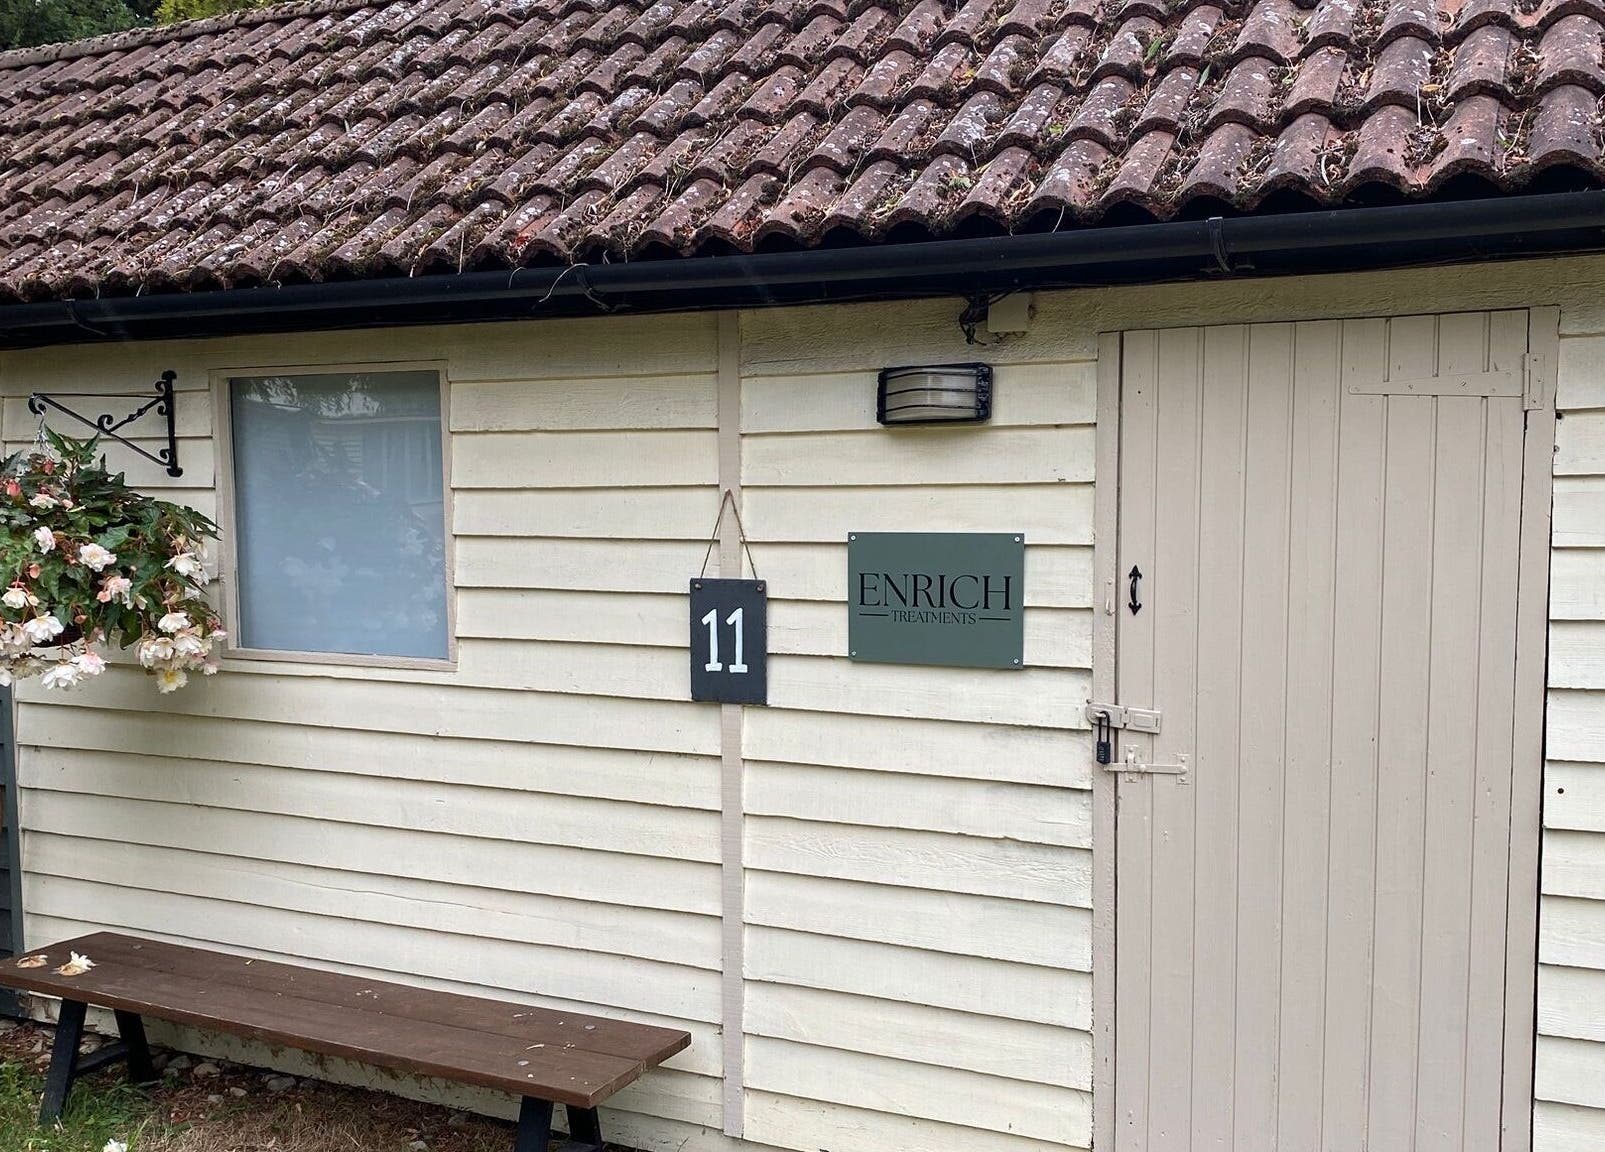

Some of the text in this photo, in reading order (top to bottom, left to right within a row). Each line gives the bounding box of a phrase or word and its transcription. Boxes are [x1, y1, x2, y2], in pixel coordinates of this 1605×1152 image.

[858, 572, 1011, 611] ENRICH
[891, 610, 977, 625] TREATMENTS
[701, 607, 748, 674] 11
